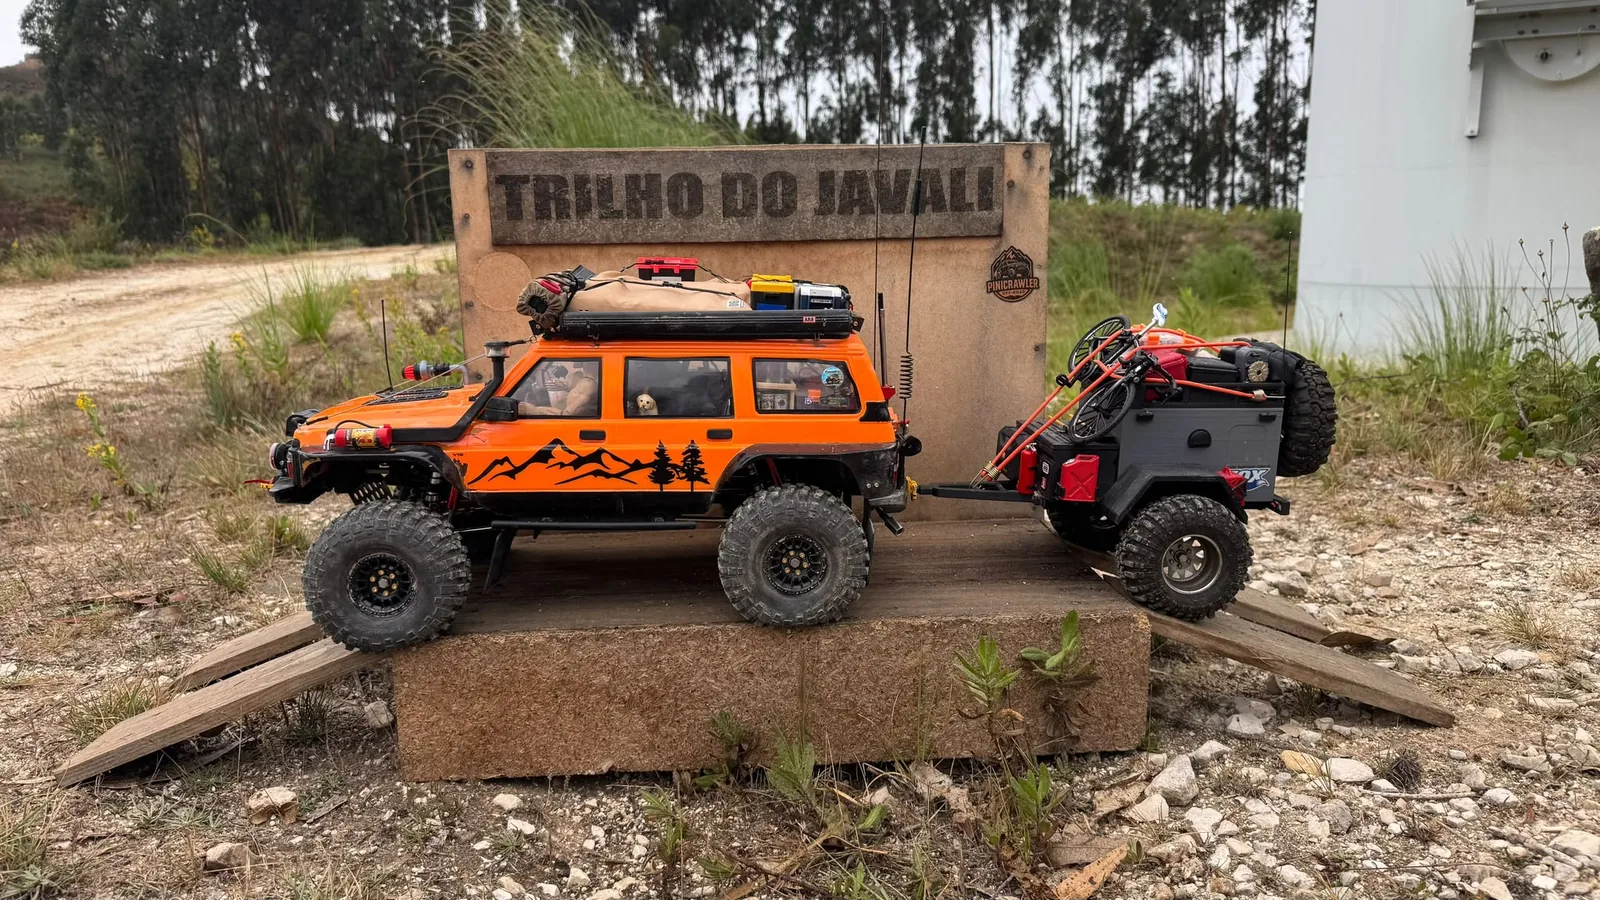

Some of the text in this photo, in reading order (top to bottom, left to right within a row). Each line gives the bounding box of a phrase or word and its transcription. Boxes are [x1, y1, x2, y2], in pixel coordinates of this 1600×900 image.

[495, 166, 994, 220] TRILHO DO JAVALI
[987, 278, 1038, 292] PINICRAWLER
[1230, 469, 1268, 483] OX
